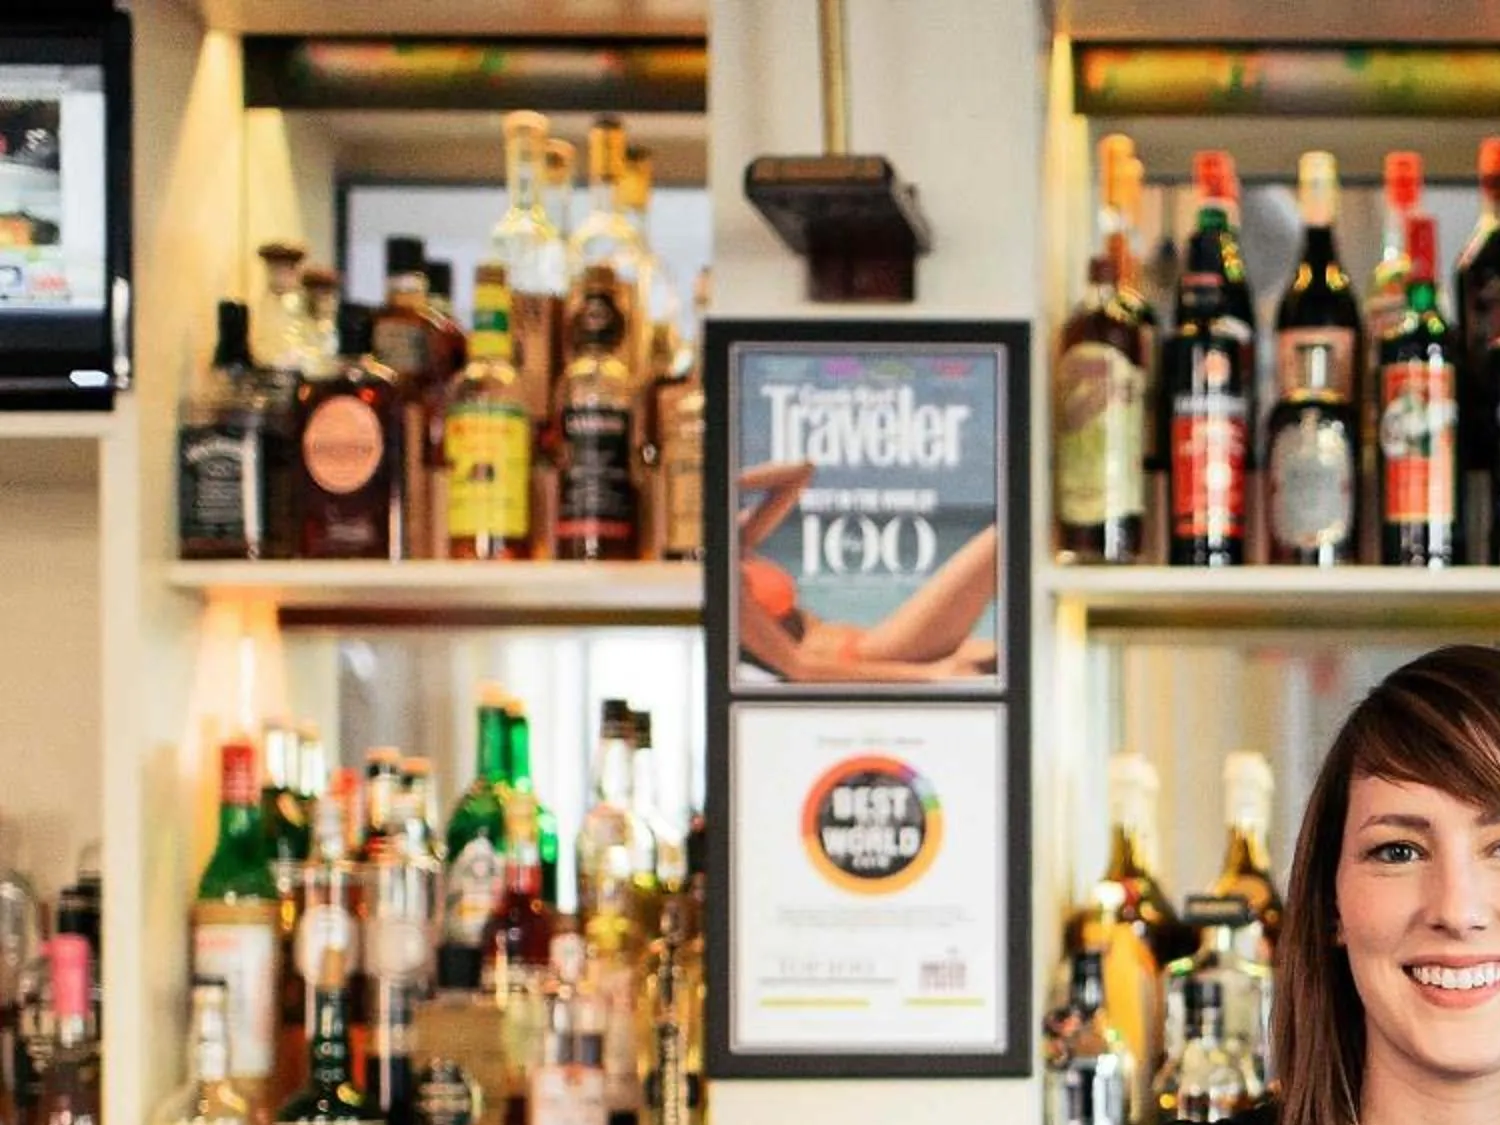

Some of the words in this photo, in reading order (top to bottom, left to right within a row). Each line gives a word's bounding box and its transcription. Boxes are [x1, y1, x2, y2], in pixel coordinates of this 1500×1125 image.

[761, 383, 972, 468] Traveler
[801, 513, 937, 577] 100
[833, 786, 909, 820] BEST
[821, 826, 921, 857] WORLD
